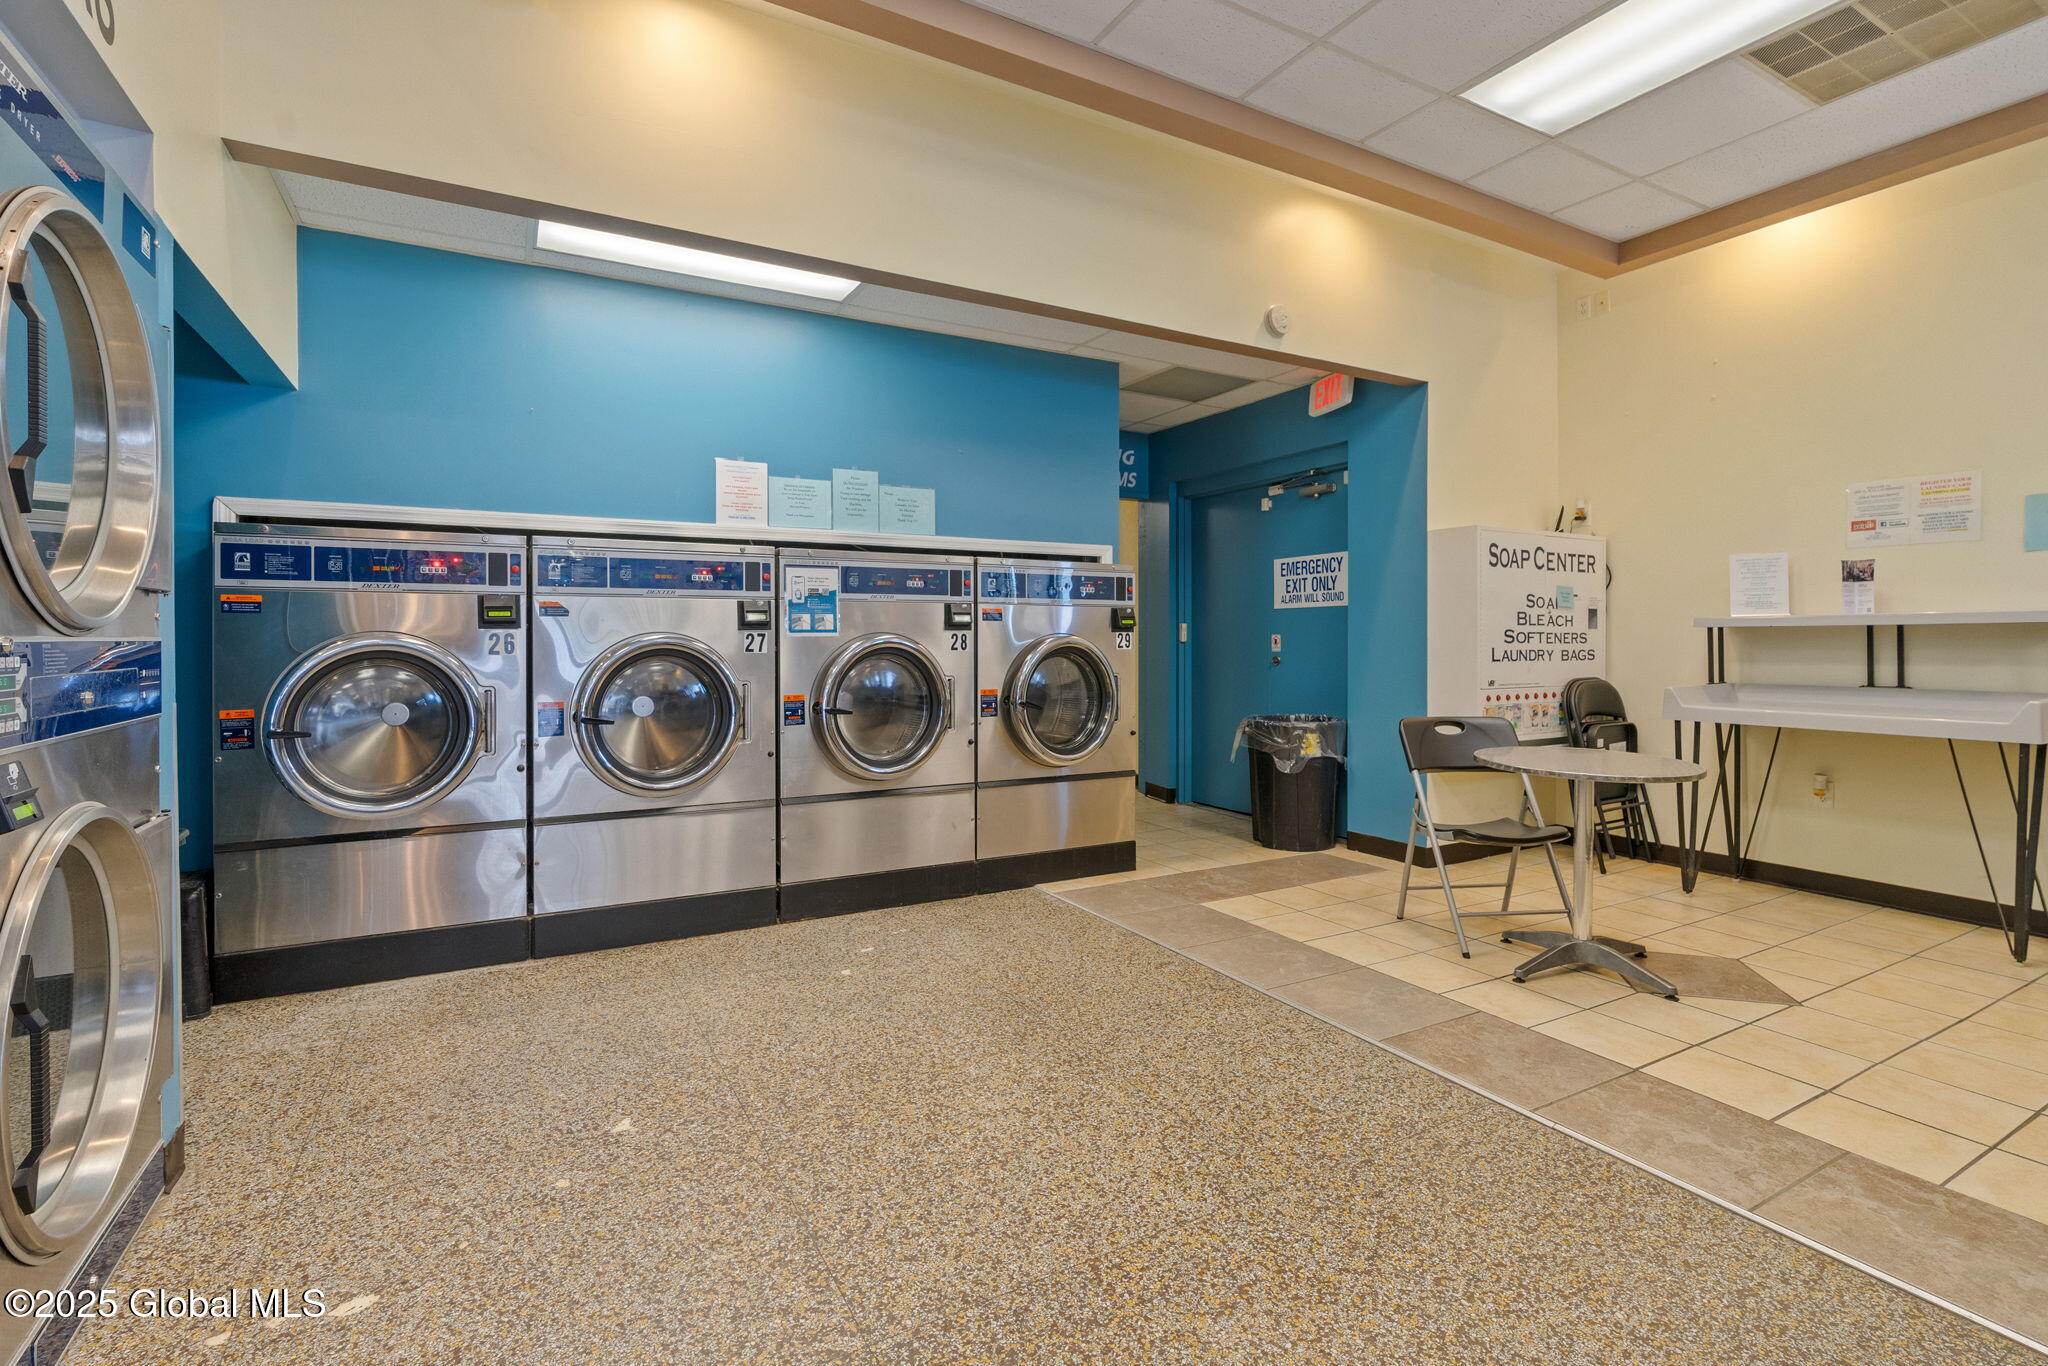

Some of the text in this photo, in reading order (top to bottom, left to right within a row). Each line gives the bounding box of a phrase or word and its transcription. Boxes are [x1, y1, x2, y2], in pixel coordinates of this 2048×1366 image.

[10, 102, 41, 142] DRYER
[1314, 372, 1345, 410] EXIT
[1280, 556, 1343, 577] EMERGENCY
[1488, 542, 1596, 574] SOAP CENTER
[1285, 575, 1337, 593] EXIT ONLY
[1280, 591, 1345, 604] ALARM WILL SOUND
[1526, 593, 1559, 610] SOA
[1516, 611, 1574, 627] BLEACH
[488, 632, 515, 656] 26
[745, 632, 766, 653] 27
[950, 633, 968, 651] 28
[1117, 632, 1131, 649] 29
[1503, 629, 1588, 645] SOFTENERS
[1491, 647, 1595, 662] LAUNDRY BAGS
